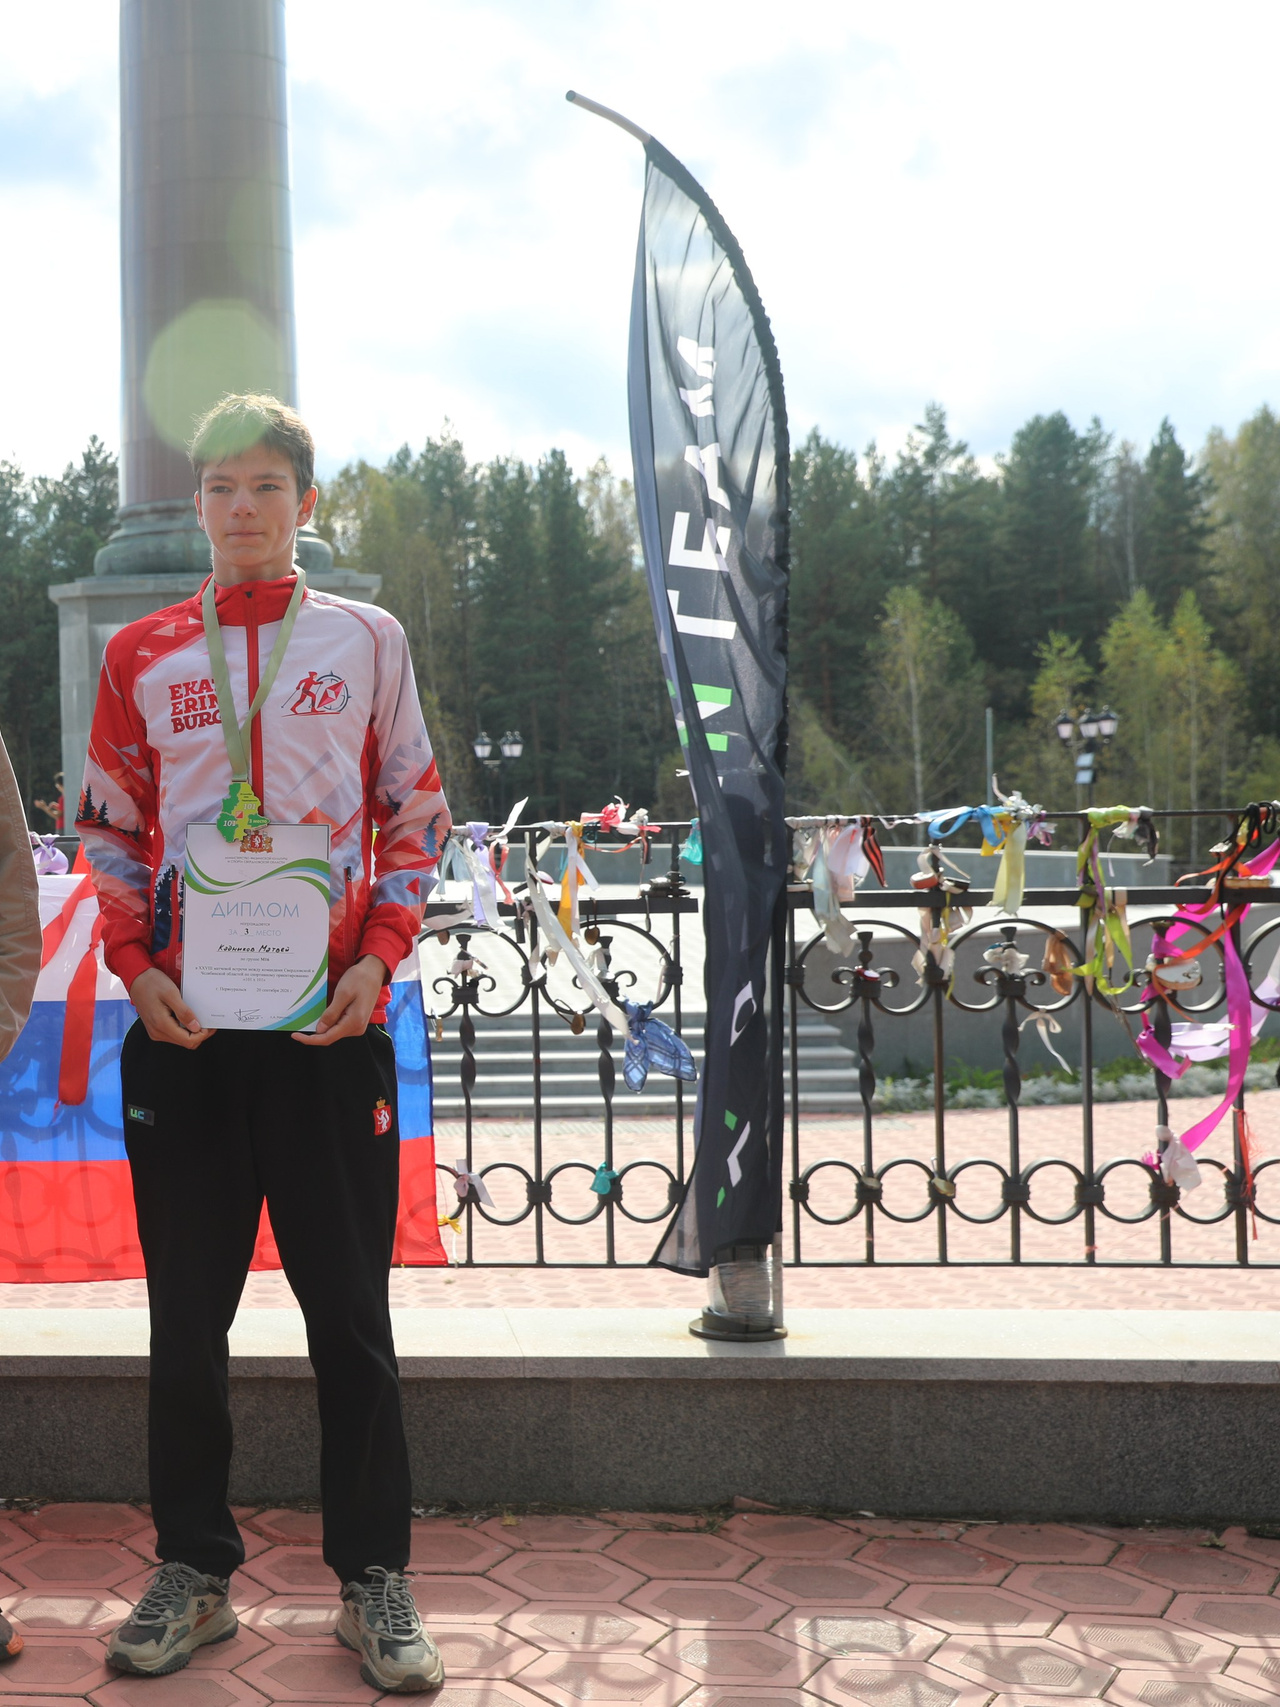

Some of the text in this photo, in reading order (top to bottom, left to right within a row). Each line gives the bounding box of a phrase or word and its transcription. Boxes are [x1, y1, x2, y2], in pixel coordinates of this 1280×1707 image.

[168, 678, 216, 700] EKA
[211, 901, 299, 918] ДИПЛОМ
[244, 928, 249, 936] 3
[217, 944, 290, 953] Кадников Матвей
